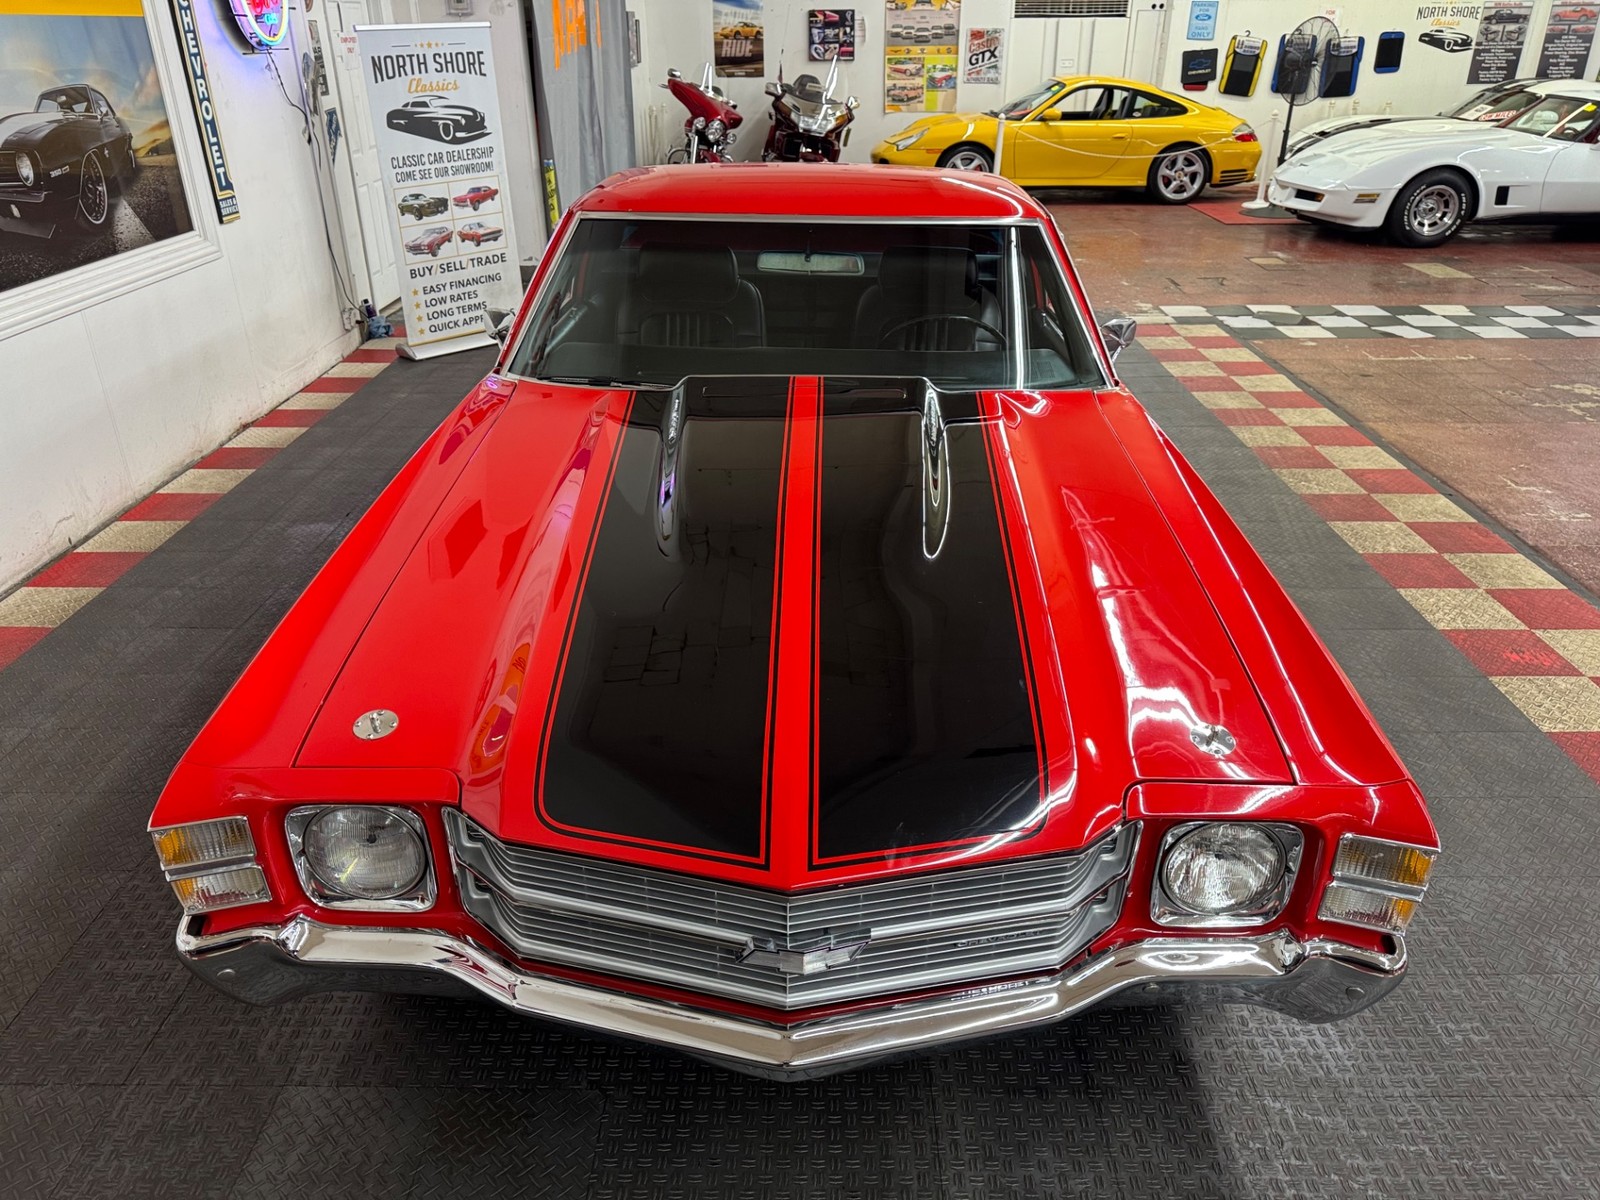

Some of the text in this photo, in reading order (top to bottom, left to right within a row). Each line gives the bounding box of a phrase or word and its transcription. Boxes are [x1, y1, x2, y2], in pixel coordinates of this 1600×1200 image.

[1417, 6, 1482, 20] NORTH SHORE
[1430, 18, 1461, 27] Classics
[721, 39, 754, 58] RIDE
[968, 46, 999, 66] GTX
[371, 51, 487, 84] NORTH SHORE
[408, 78, 460, 94] Classics
[391, 146, 494, 169] CLASSIC CAR DEALERSHIP
[395, 161, 494, 183] COME SEE OUR SHOWROOM!
[219, 198, 233, 208] SALES
[422, 272, 502, 295] EASY FINANCING
[424, 290, 478, 308] LOW RATES
[426, 301, 487, 321] LONG TERMS
[428, 320, 460, 334] QUICK
[957, 930, 1040, 947] CHEVROLET
